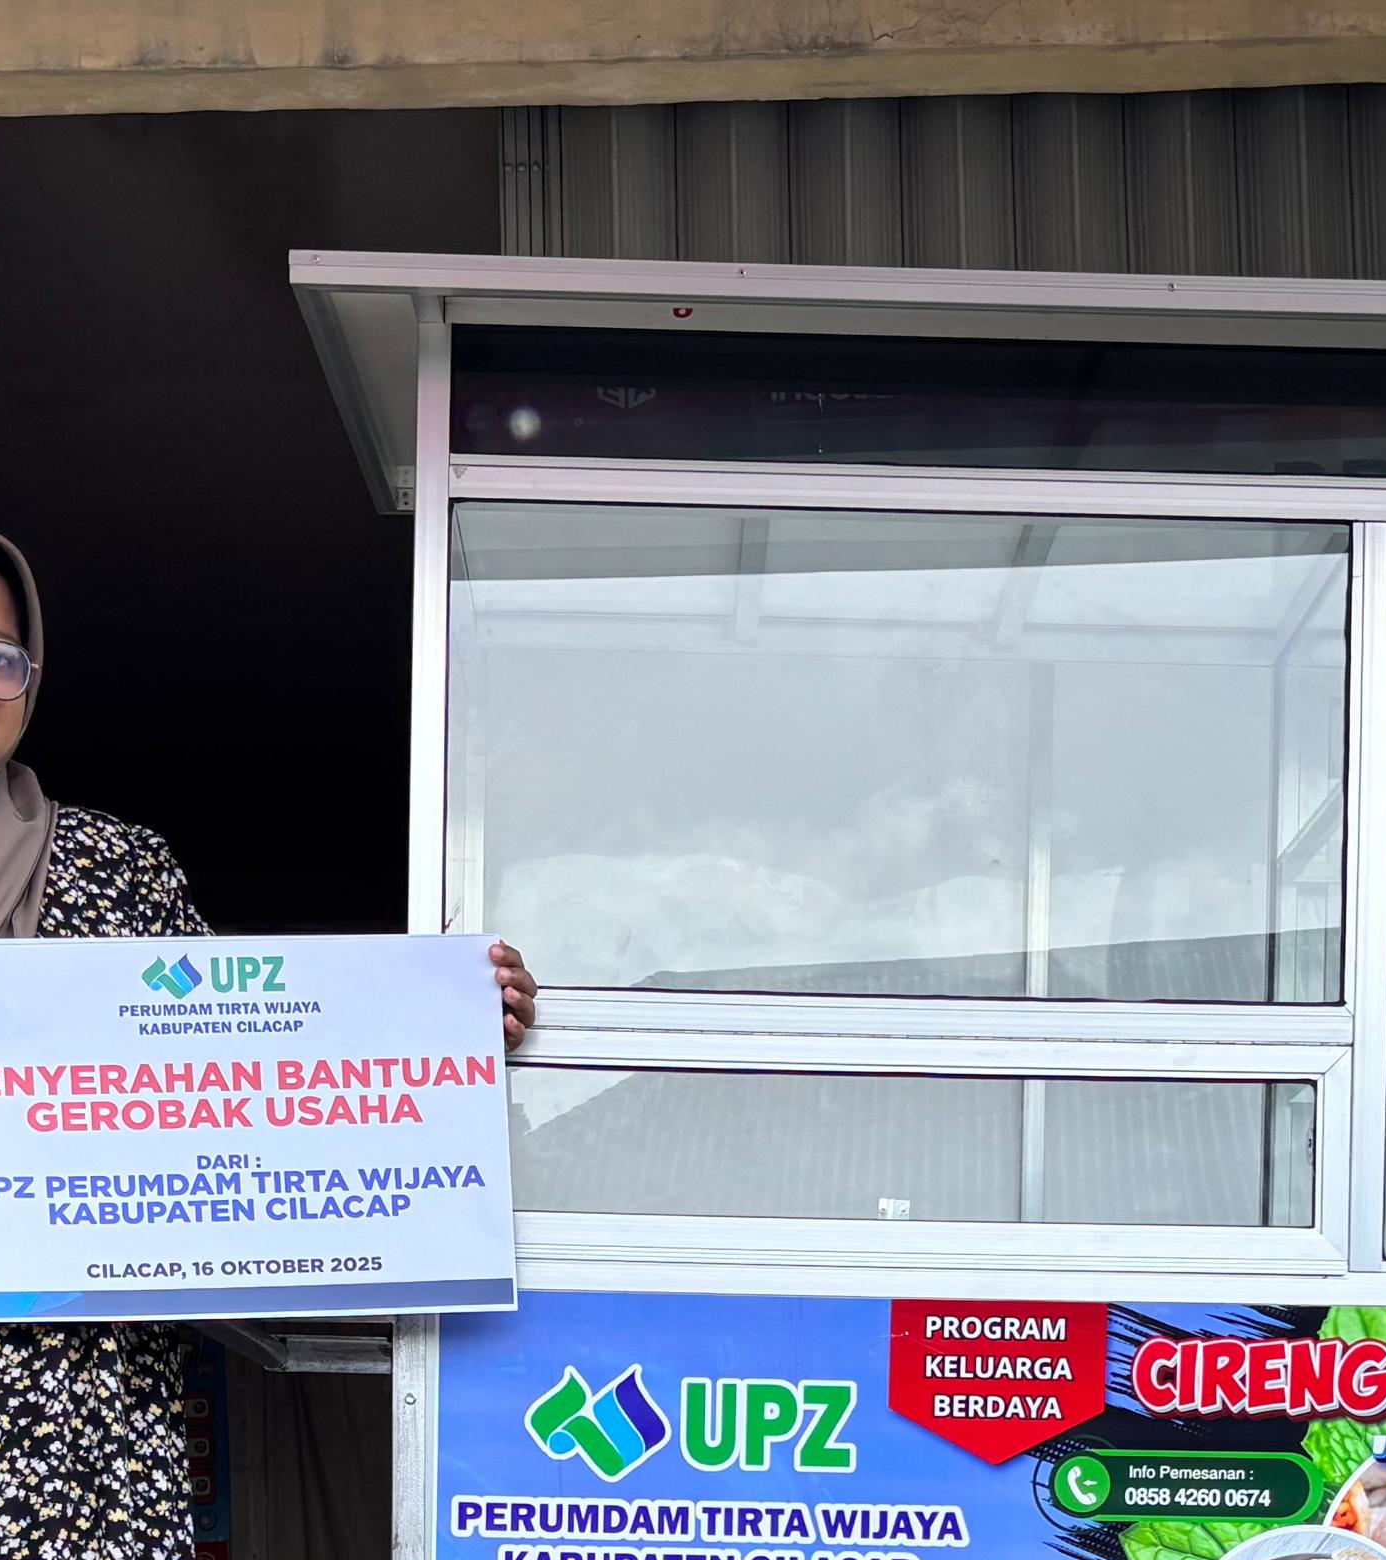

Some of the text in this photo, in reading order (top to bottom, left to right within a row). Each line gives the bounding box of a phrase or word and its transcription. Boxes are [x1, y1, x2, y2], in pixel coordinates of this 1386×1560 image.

[211, 955, 286, 993] UPZ
[119, 1001, 321, 1017] PERUMDAM TIRTA WIJAYA
[139, 1019, 304, 1036] KABUPATEN CILACAP
[277, 1056, 497, 1091] BANTUAN
[26, 1093, 423, 1133] GEROBAK USAHA
[196, 1154, 261, 1170] DARI :
[46, 1171, 238, 1197] PERUMDAM
[251, 1168, 347, 1194] TIRTA
[356, 1165, 485, 1191] WIJAYA
[48, 1194, 411, 1226] KABUPATEN CILACAP
[87, 1256, 383, 1280] CILACAP, 16 OKTOBER 2025
[925, 1316, 1067, 1342] PROGRAM
[924, 1355, 1073, 1381] KELUARGA
[932, 1394, 1063, 1420] BERDAYA
[680, 1376, 857, 1473] UPZ
[1129, 1465, 1253, 1480] Info Pemesanan :
[1125, 1488, 1271, 1506] 0858 4260 0674
[454, 1498, 966, 1544] PERUMDAM TIRTA WIJAYA
